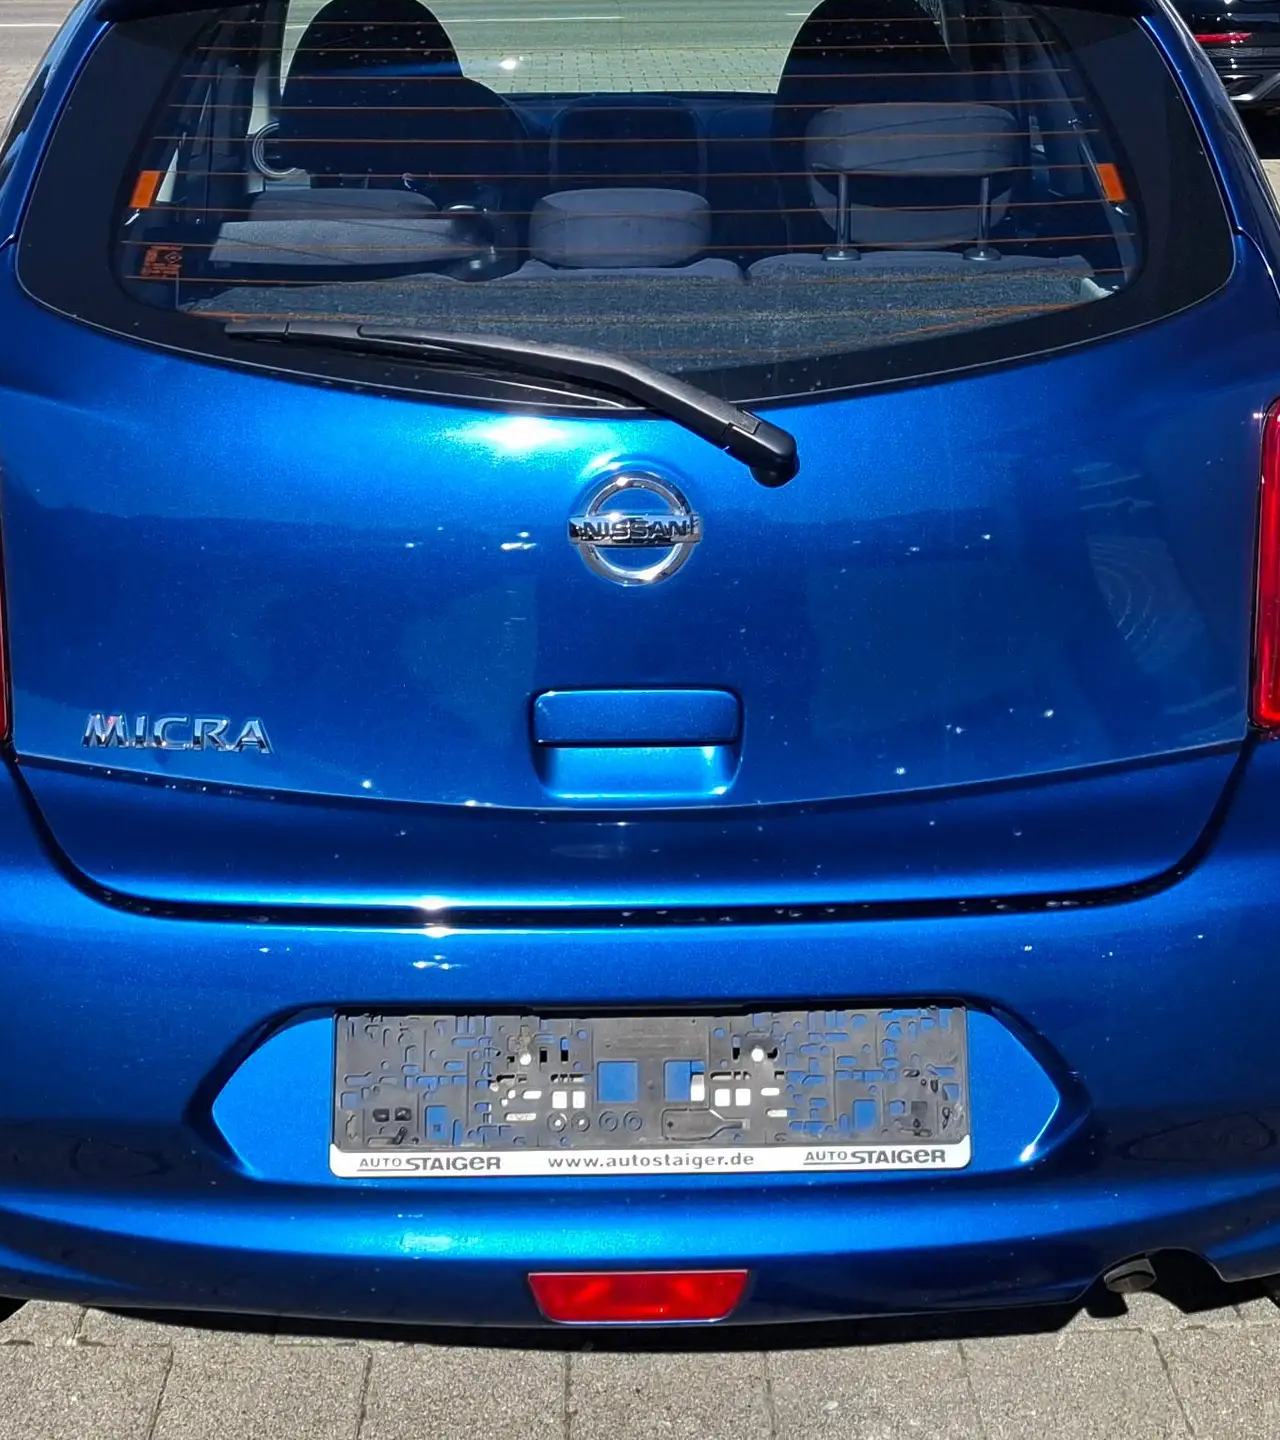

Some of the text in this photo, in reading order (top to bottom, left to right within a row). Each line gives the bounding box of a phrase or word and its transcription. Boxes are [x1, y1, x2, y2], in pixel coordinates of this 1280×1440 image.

[582, 519, 687, 541] NISSAN
[81, 712, 274, 754] MICRA
[359, 1156, 502, 1171] AUTO STAIGER
[548, 1152, 755, 1171] www.autostaiger.de
[804, 1148, 947, 1164] AUTO STAIGER
